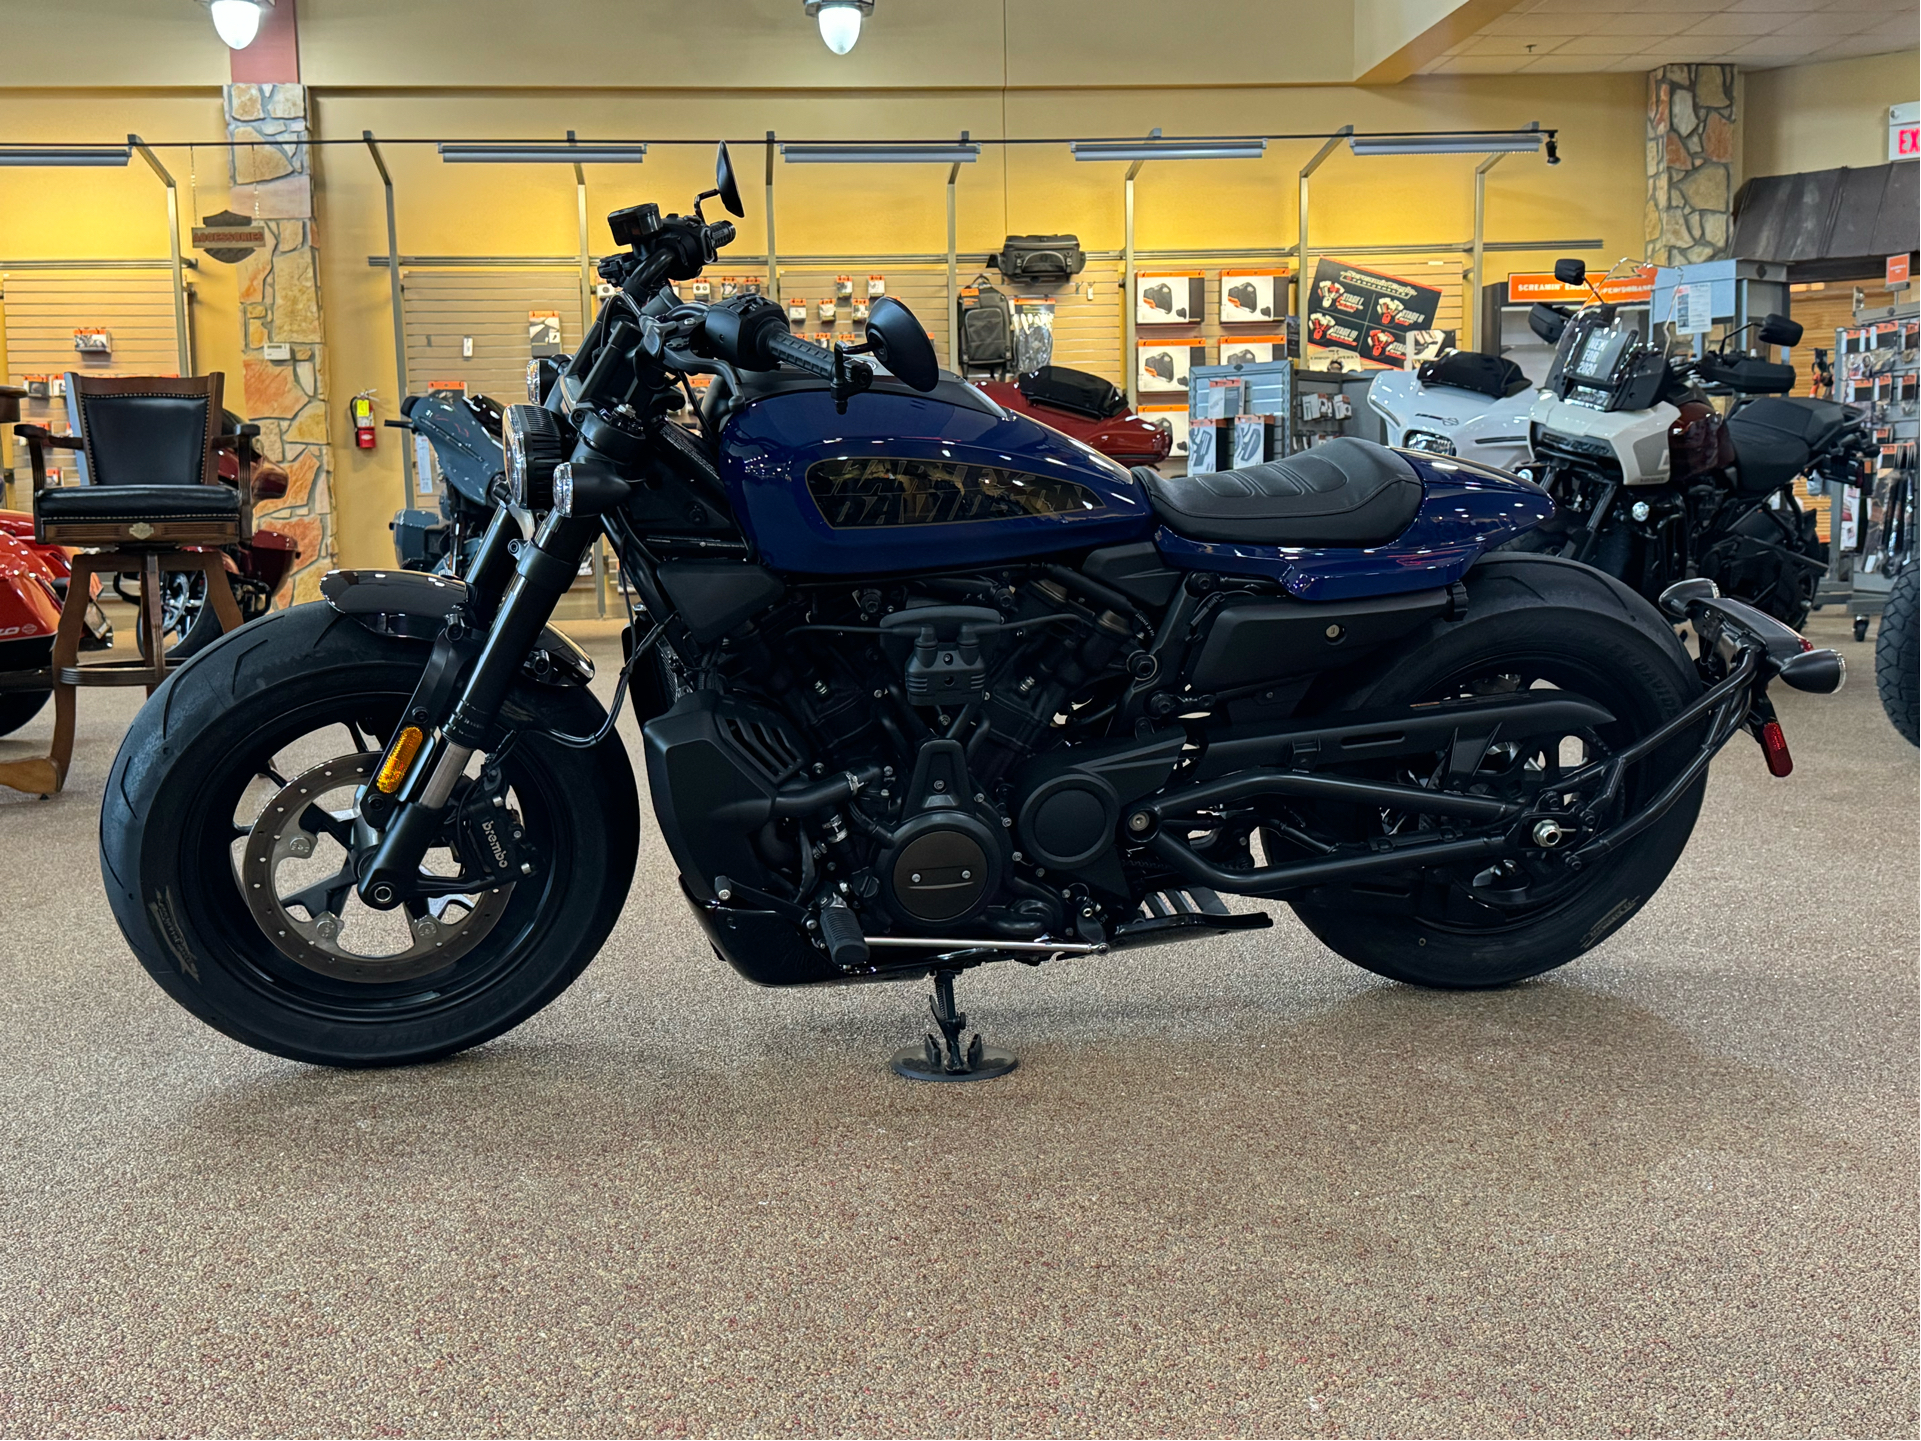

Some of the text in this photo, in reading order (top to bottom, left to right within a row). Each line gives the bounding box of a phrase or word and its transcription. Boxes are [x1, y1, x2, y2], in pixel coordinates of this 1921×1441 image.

[193, 231, 263, 242] ACCESSORIES
[1518, 284, 1562, 292] SCREAMIN'
[1588, 337, 1609, 351] NEW
[1582, 349, 1600, 362] FOR
[1576, 361, 1598, 377] 2024
[482, 820, 508, 868] brembo
